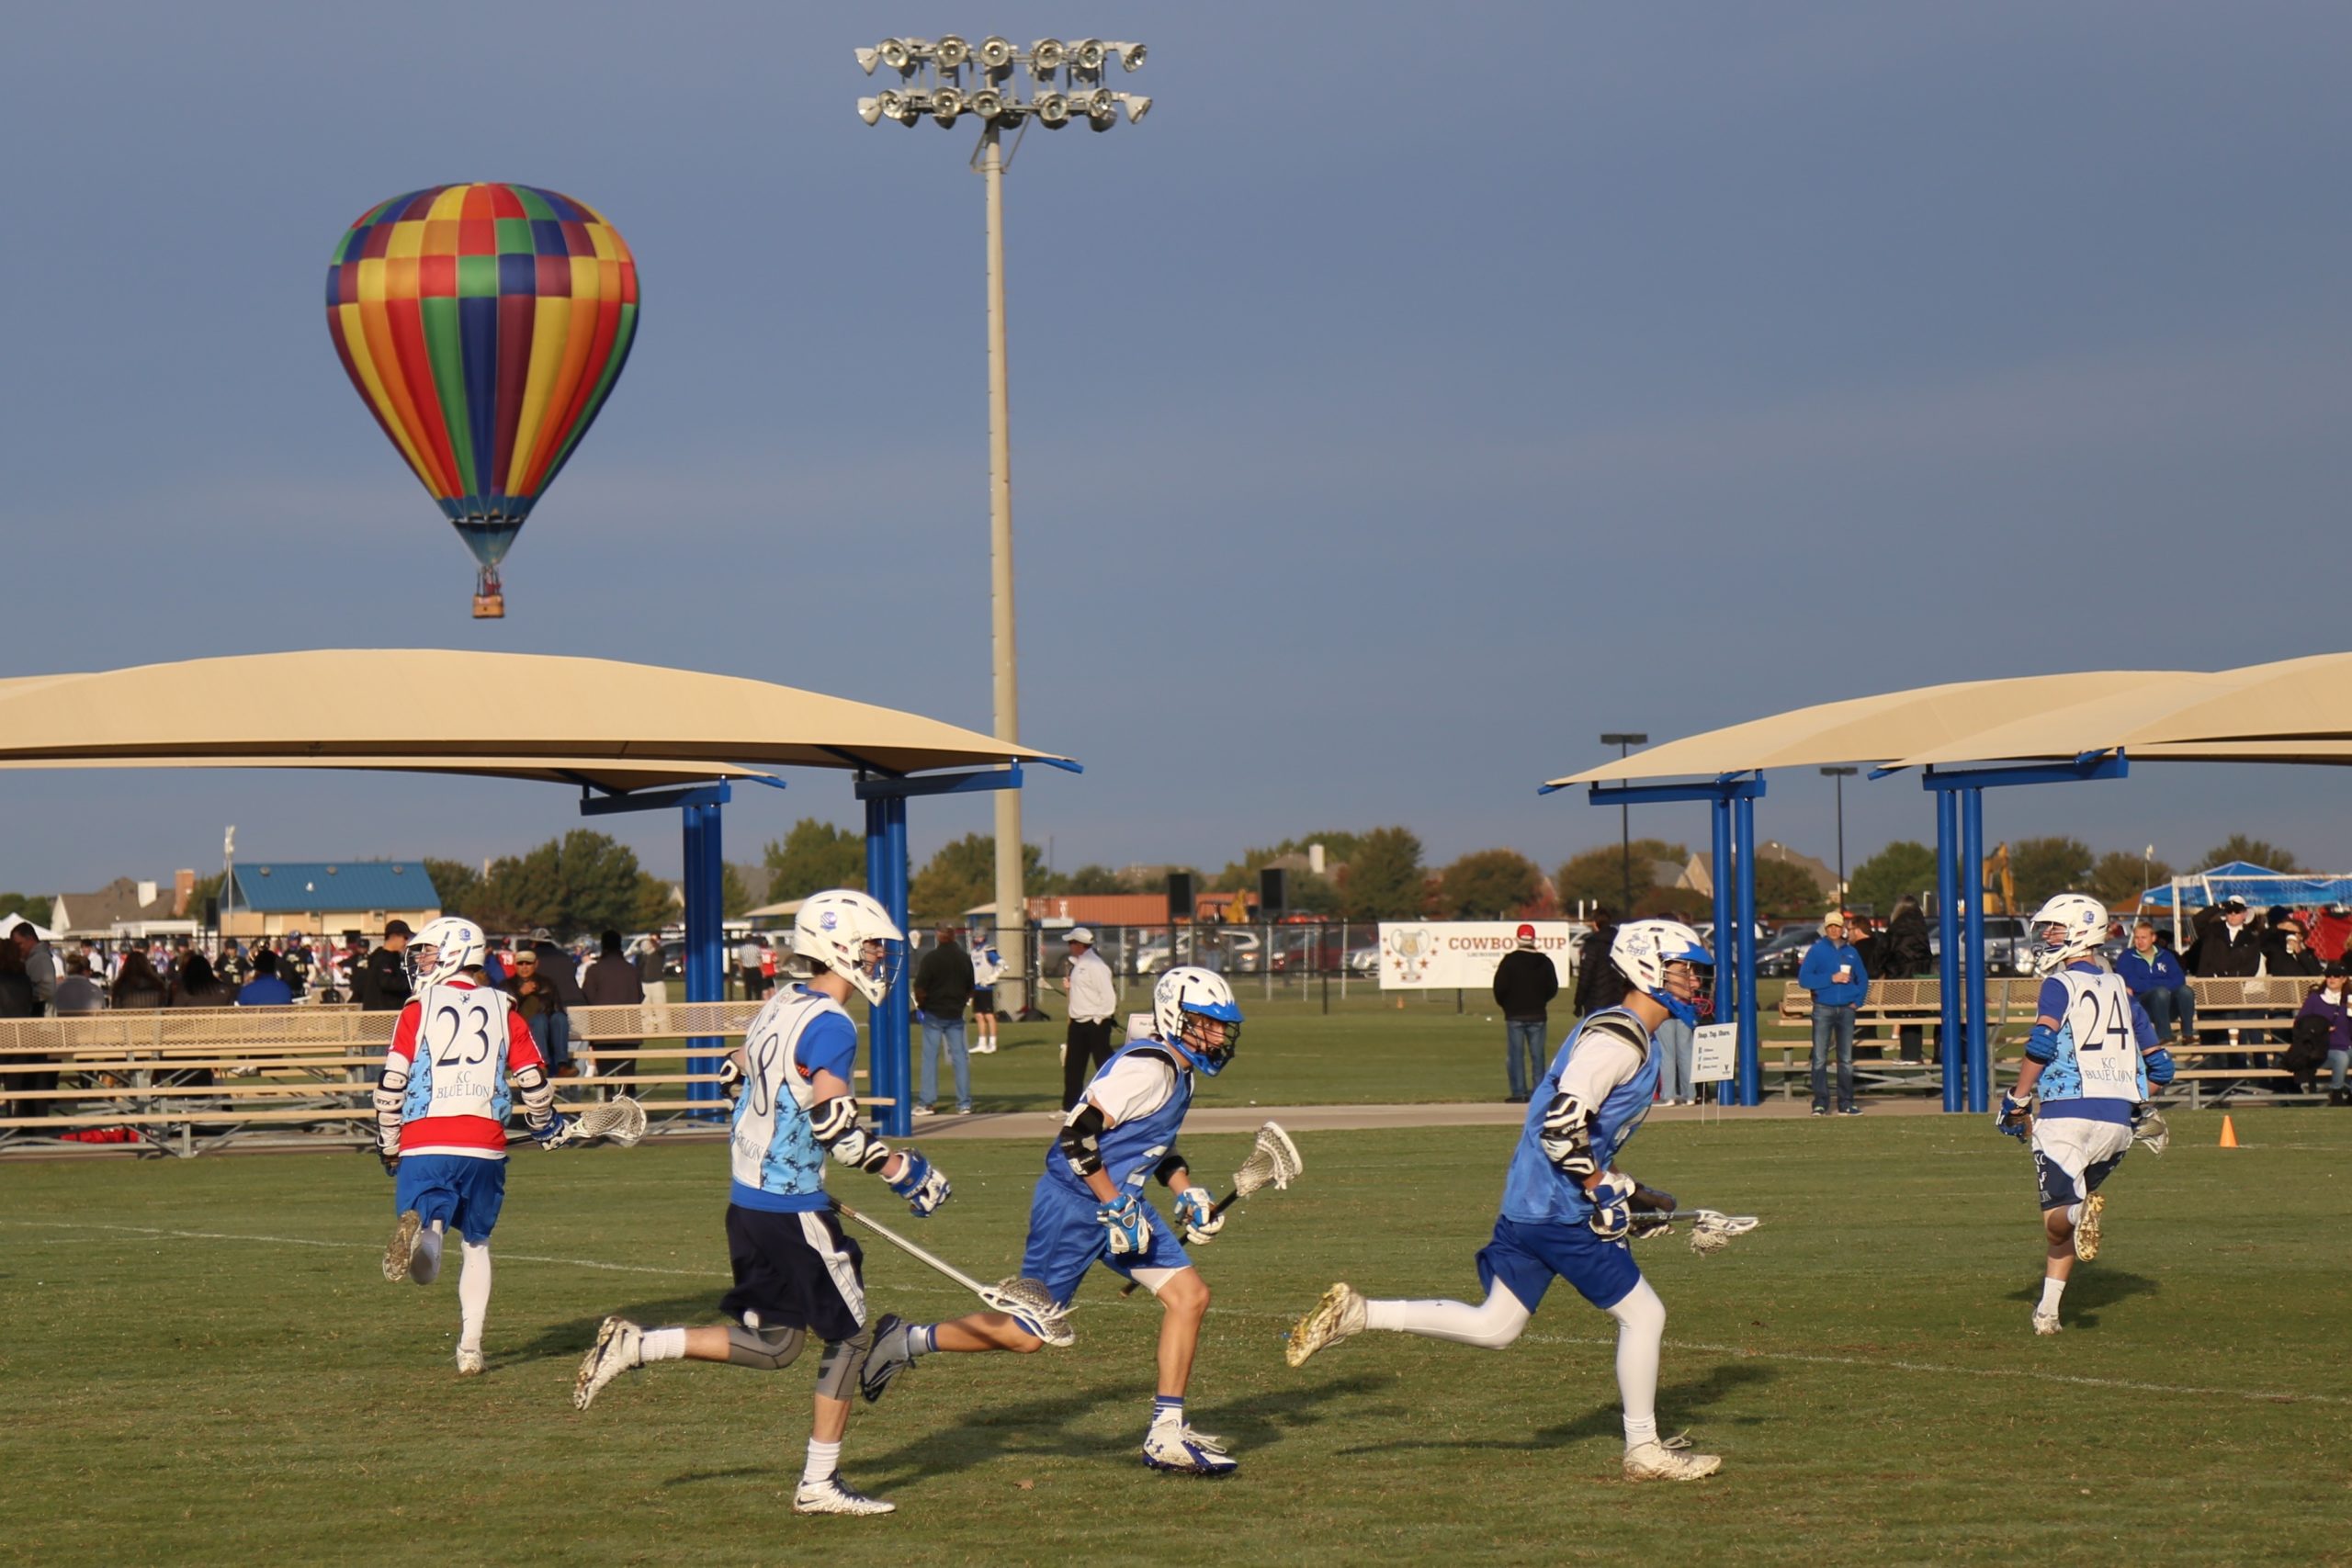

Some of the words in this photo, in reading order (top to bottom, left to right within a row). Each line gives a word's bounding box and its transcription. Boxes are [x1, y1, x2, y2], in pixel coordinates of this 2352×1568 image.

[1449, 937, 1518, 950] COWBO
[1533, 937, 1566, 950] CUP
[2079, 989, 2129, 1051] 24
[435, 1005, 490, 1066] 23
[2100, 1057, 2117, 1069] KC
[456, 1070, 471, 1084] KC
[2085, 1069, 2112, 1081] BLUE
[2112, 1069, 2133, 1083] LION
[436, 1084, 464, 1099] BLUE
[465, 1083, 491, 1098] LION
